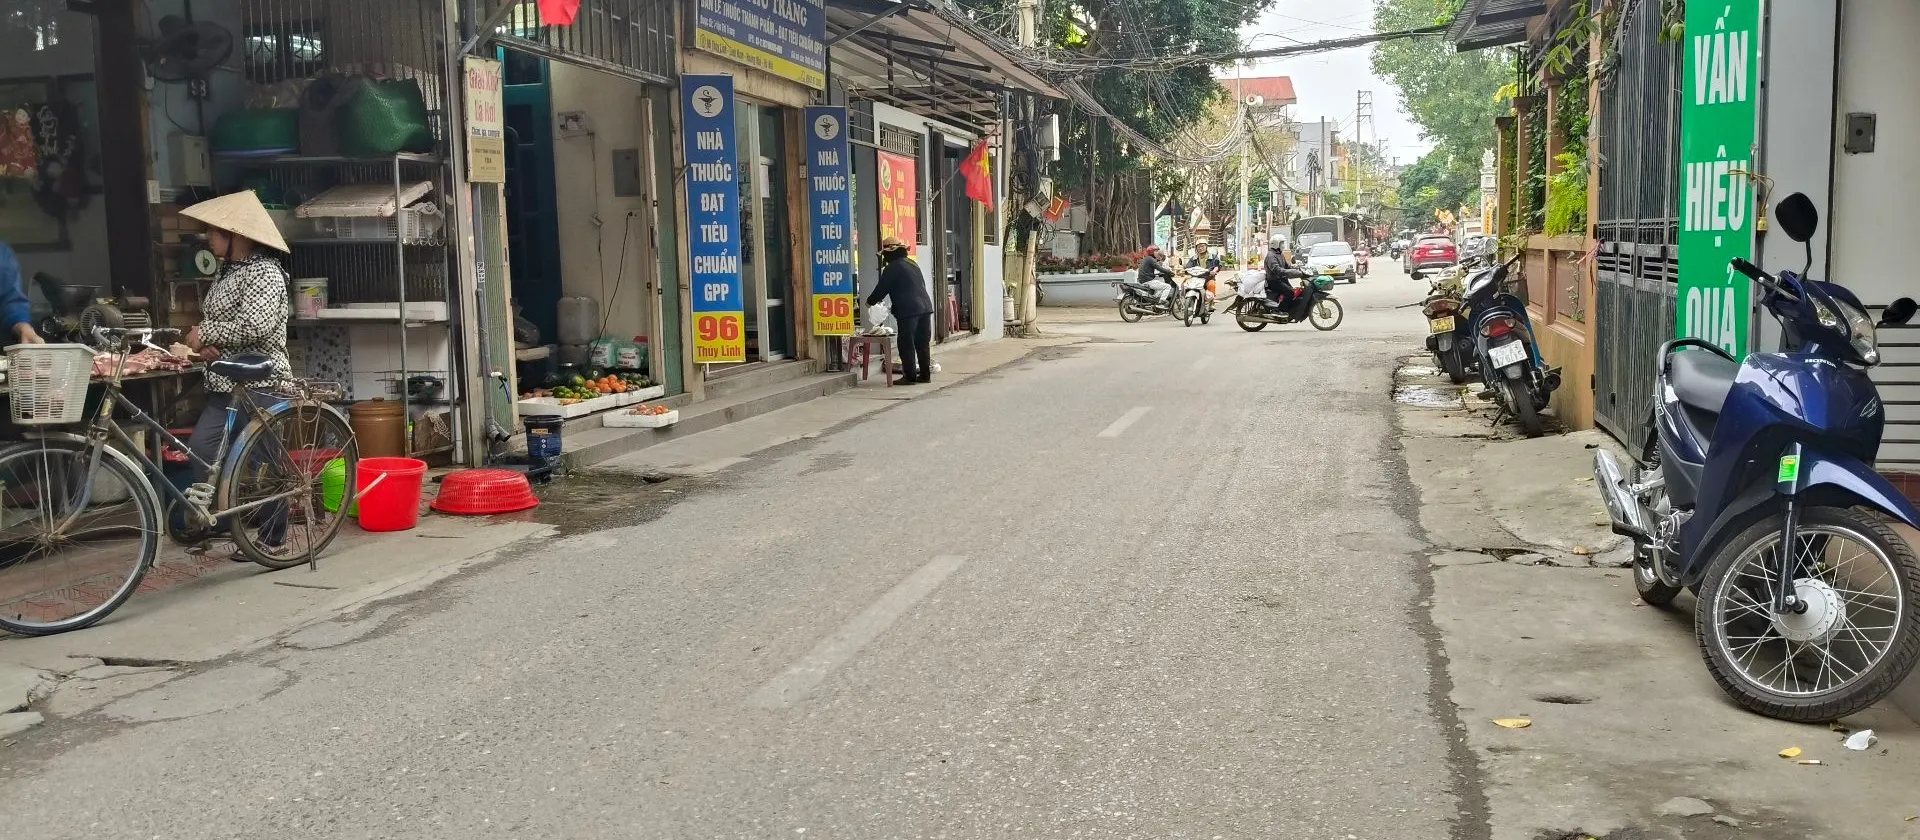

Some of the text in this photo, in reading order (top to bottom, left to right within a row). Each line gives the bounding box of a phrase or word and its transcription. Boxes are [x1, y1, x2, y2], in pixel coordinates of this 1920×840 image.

[1694, 5, 1749, 105] VẤN
[696, 127, 724, 150] NHÀ
[817, 147, 840, 166] NHÀ
[690, 156, 732, 182] THUỐC
[813, 171, 846, 191] THUỐC
[700, 193, 725, 216] ĐẠT
[1684, 144, 1748, 248] HIỆU
[820, 199, 840, 218] ĐẠT
[700, 220, 728, 243] TIÊU
[820, 222, 842, 240] TIÊU
[694, 248, 737, 274] CHUẨN
[815, 243, 849, 264] CHUẨN
[823, 271, 843, 287] GPP
[703, 283, 729, 302] GPP
[818, 297, 850, 318] 96
[1685, 256, 1737, 357] QUẢ
[698, 315, 739, 342] 96
[1804, 358, 1838, 369] HONDA
